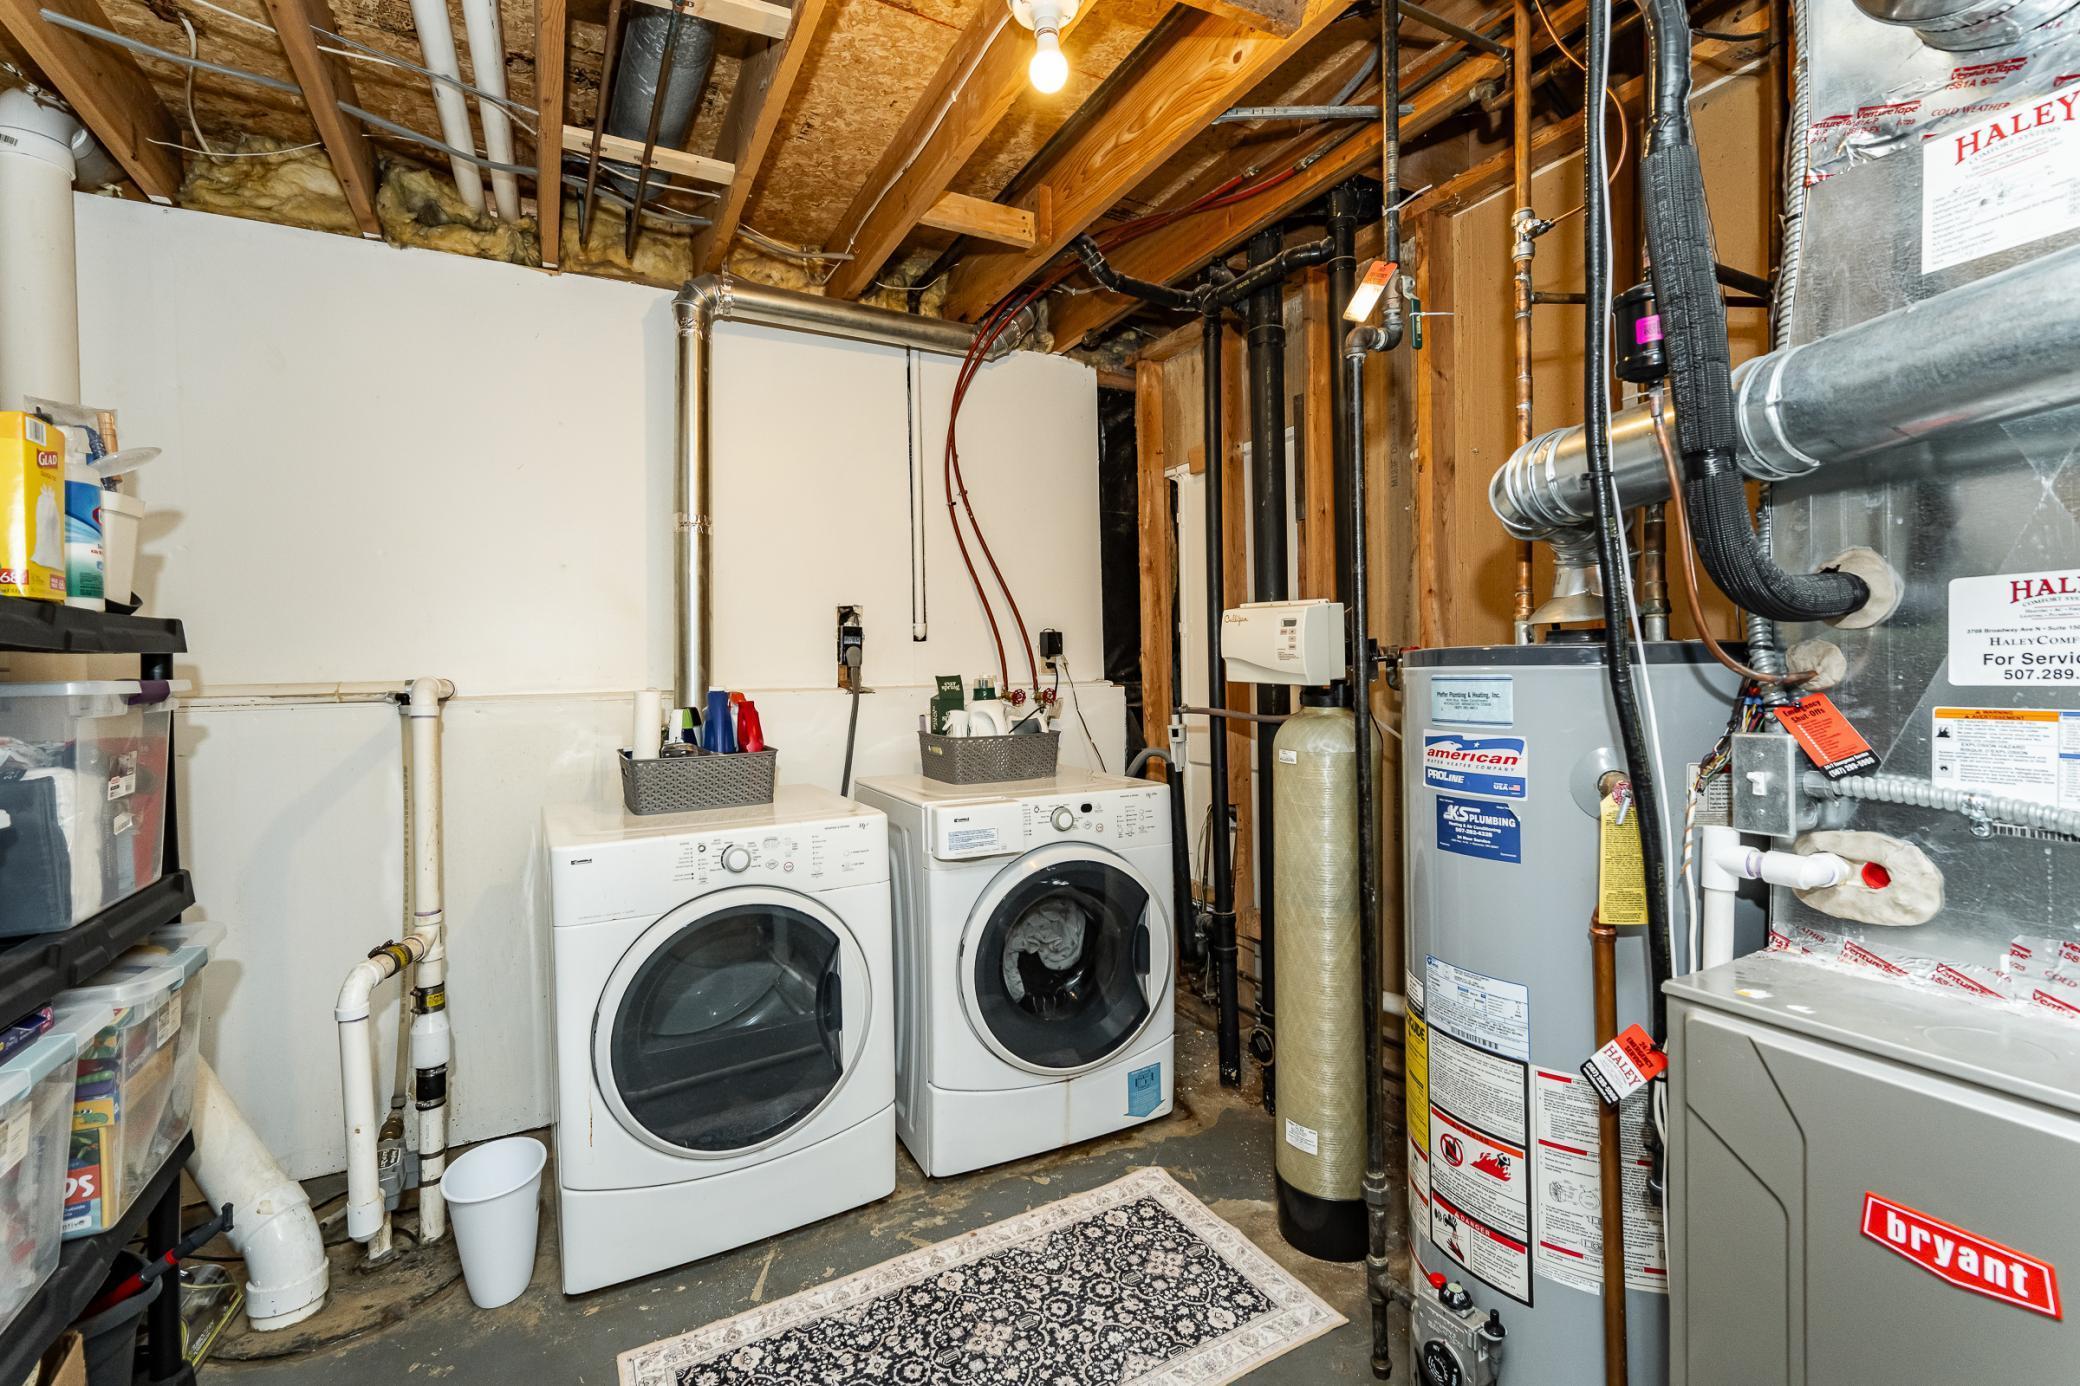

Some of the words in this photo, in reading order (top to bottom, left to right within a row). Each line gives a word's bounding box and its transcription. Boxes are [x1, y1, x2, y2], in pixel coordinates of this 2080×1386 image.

[1955, 90, 2080, 166] HALEY
[38, 452, 57, 466] GLAD
[2010, 576, 2080, 604] HAL
[1983, 653, 2015, 666] For
[1427, 748, 1519, 766] american
[1427, 768, 1465, 784] PROLINE
[1476, 764, 1515, 772] COMPANY
[1469, 813, 1516, 828] PLUMBING
[1603, 1045, 1642, 1087] HALEY
[1460, 1214, 1491, 1237] DANGER
[1886, 1210, 2029, 1299] bryant
